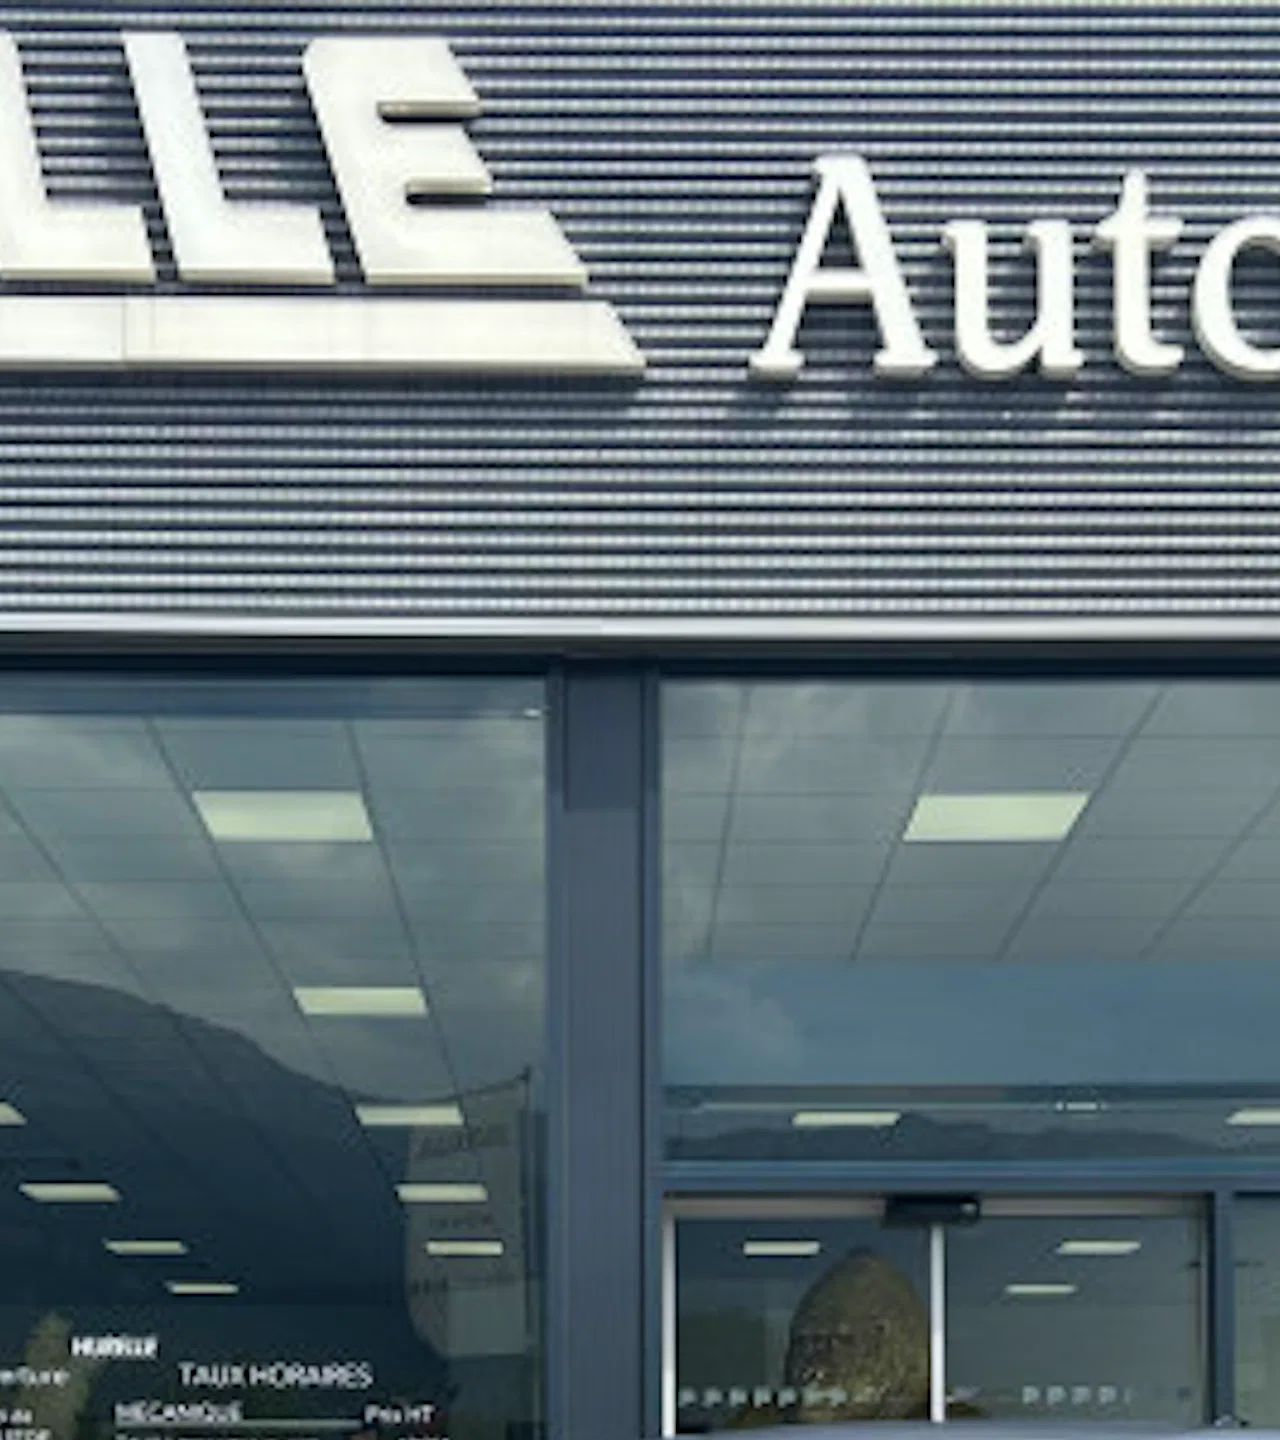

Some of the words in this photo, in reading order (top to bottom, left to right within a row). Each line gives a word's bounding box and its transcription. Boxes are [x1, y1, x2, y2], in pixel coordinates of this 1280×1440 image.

[178, 1362, 245, 1387] TAUX
[249, 1361, 373, 1388] HORAIRES
[406, 1404, 435, 1423] HT
